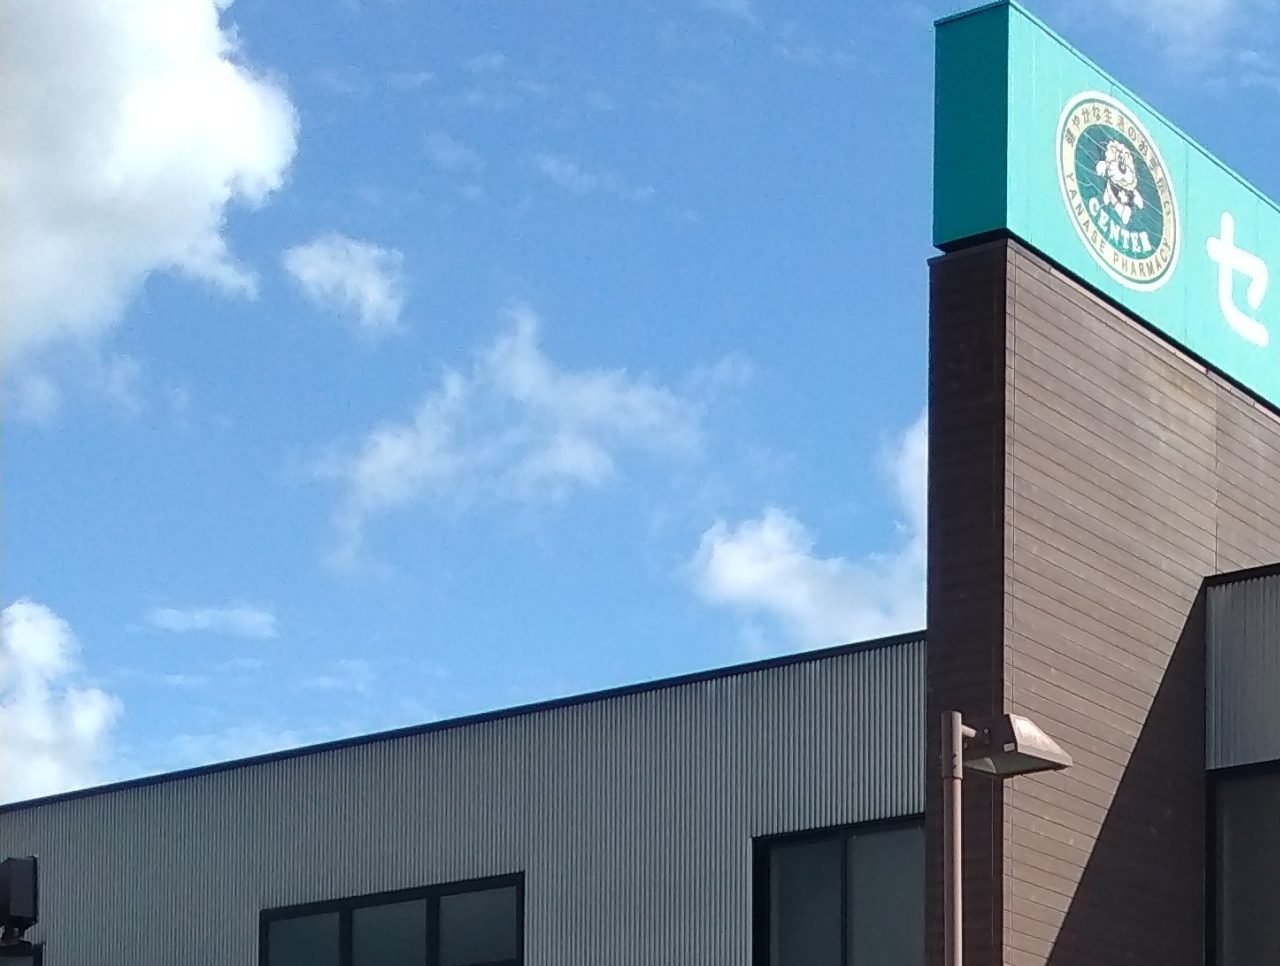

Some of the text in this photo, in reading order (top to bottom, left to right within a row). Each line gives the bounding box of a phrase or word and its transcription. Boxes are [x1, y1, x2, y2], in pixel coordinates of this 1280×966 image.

[1065, 172, 1172, 278] YANASE PHARMACY
[1088, 197, 1153, 253] CENTER
